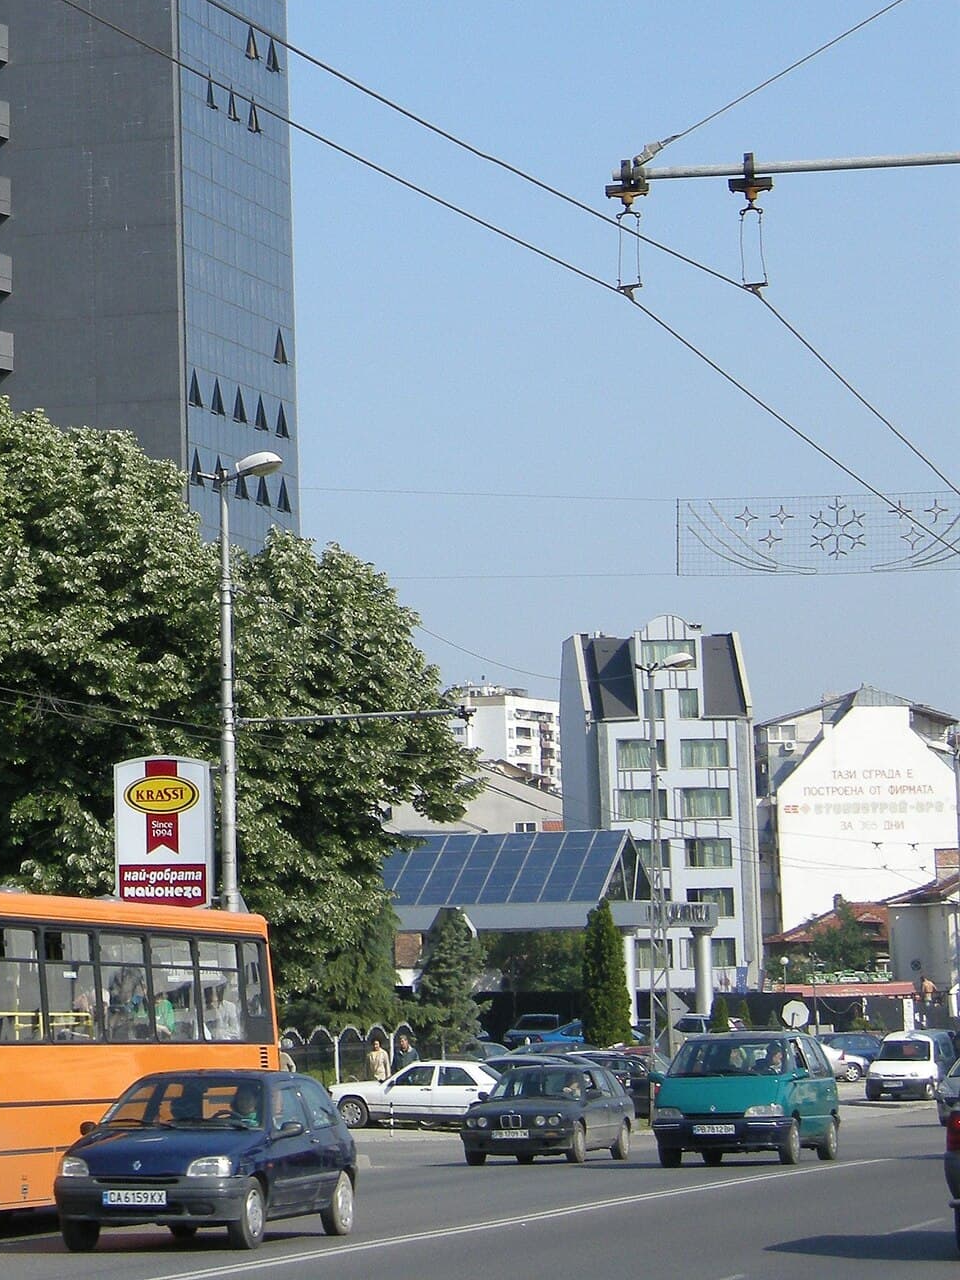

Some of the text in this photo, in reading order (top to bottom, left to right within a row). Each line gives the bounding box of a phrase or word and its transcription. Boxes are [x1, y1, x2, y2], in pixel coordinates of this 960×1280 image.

[832, 769, 913, 780] ТАЗИ СГРАДА Е
[136, 787, 184, 802] KRASSI
[803, 784, 934, 797] ПОСТРОЕНА ОТ ФИРМАТА
[151, 821, 173, 829] Since
[840, 821, 853, 830] ЗА
[883, 821, 905, 831] ДНИ
[152, 829, 173, 837] 1994
[124, 868, 202, 884] най-добрата
[124, 885, 202, 899] майонеза
